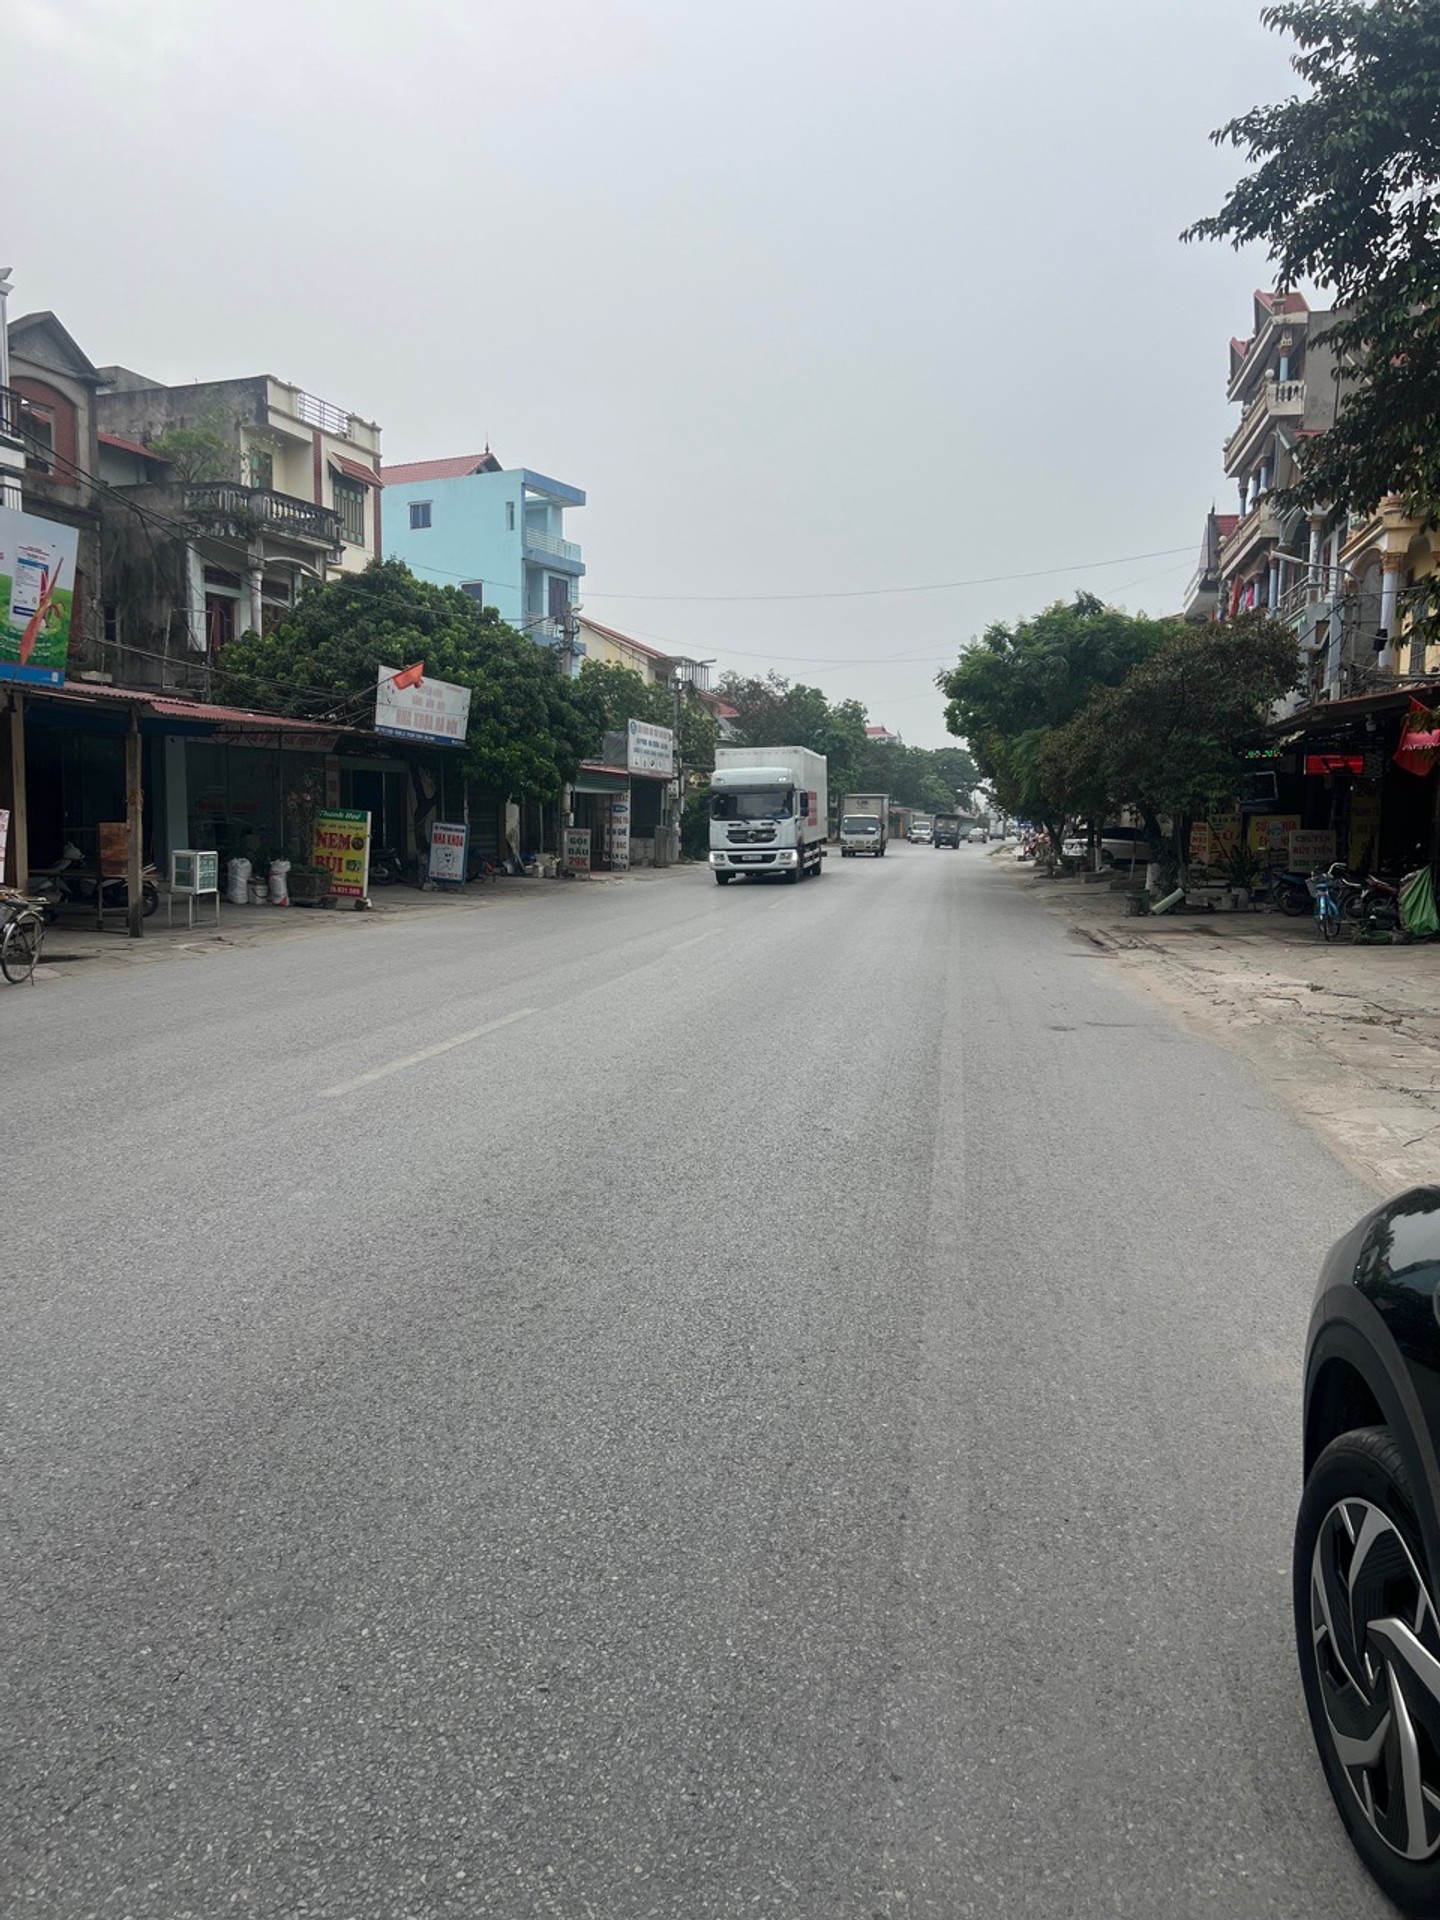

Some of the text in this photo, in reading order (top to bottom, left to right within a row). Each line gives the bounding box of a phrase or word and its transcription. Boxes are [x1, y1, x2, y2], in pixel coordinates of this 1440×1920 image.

[316, 831, 351, 850] NEM
[433, 832, 464, 847] NHA KHOA
[569, 836, 588, 847] GỘI
[568, 856, 588, 867] 29K
